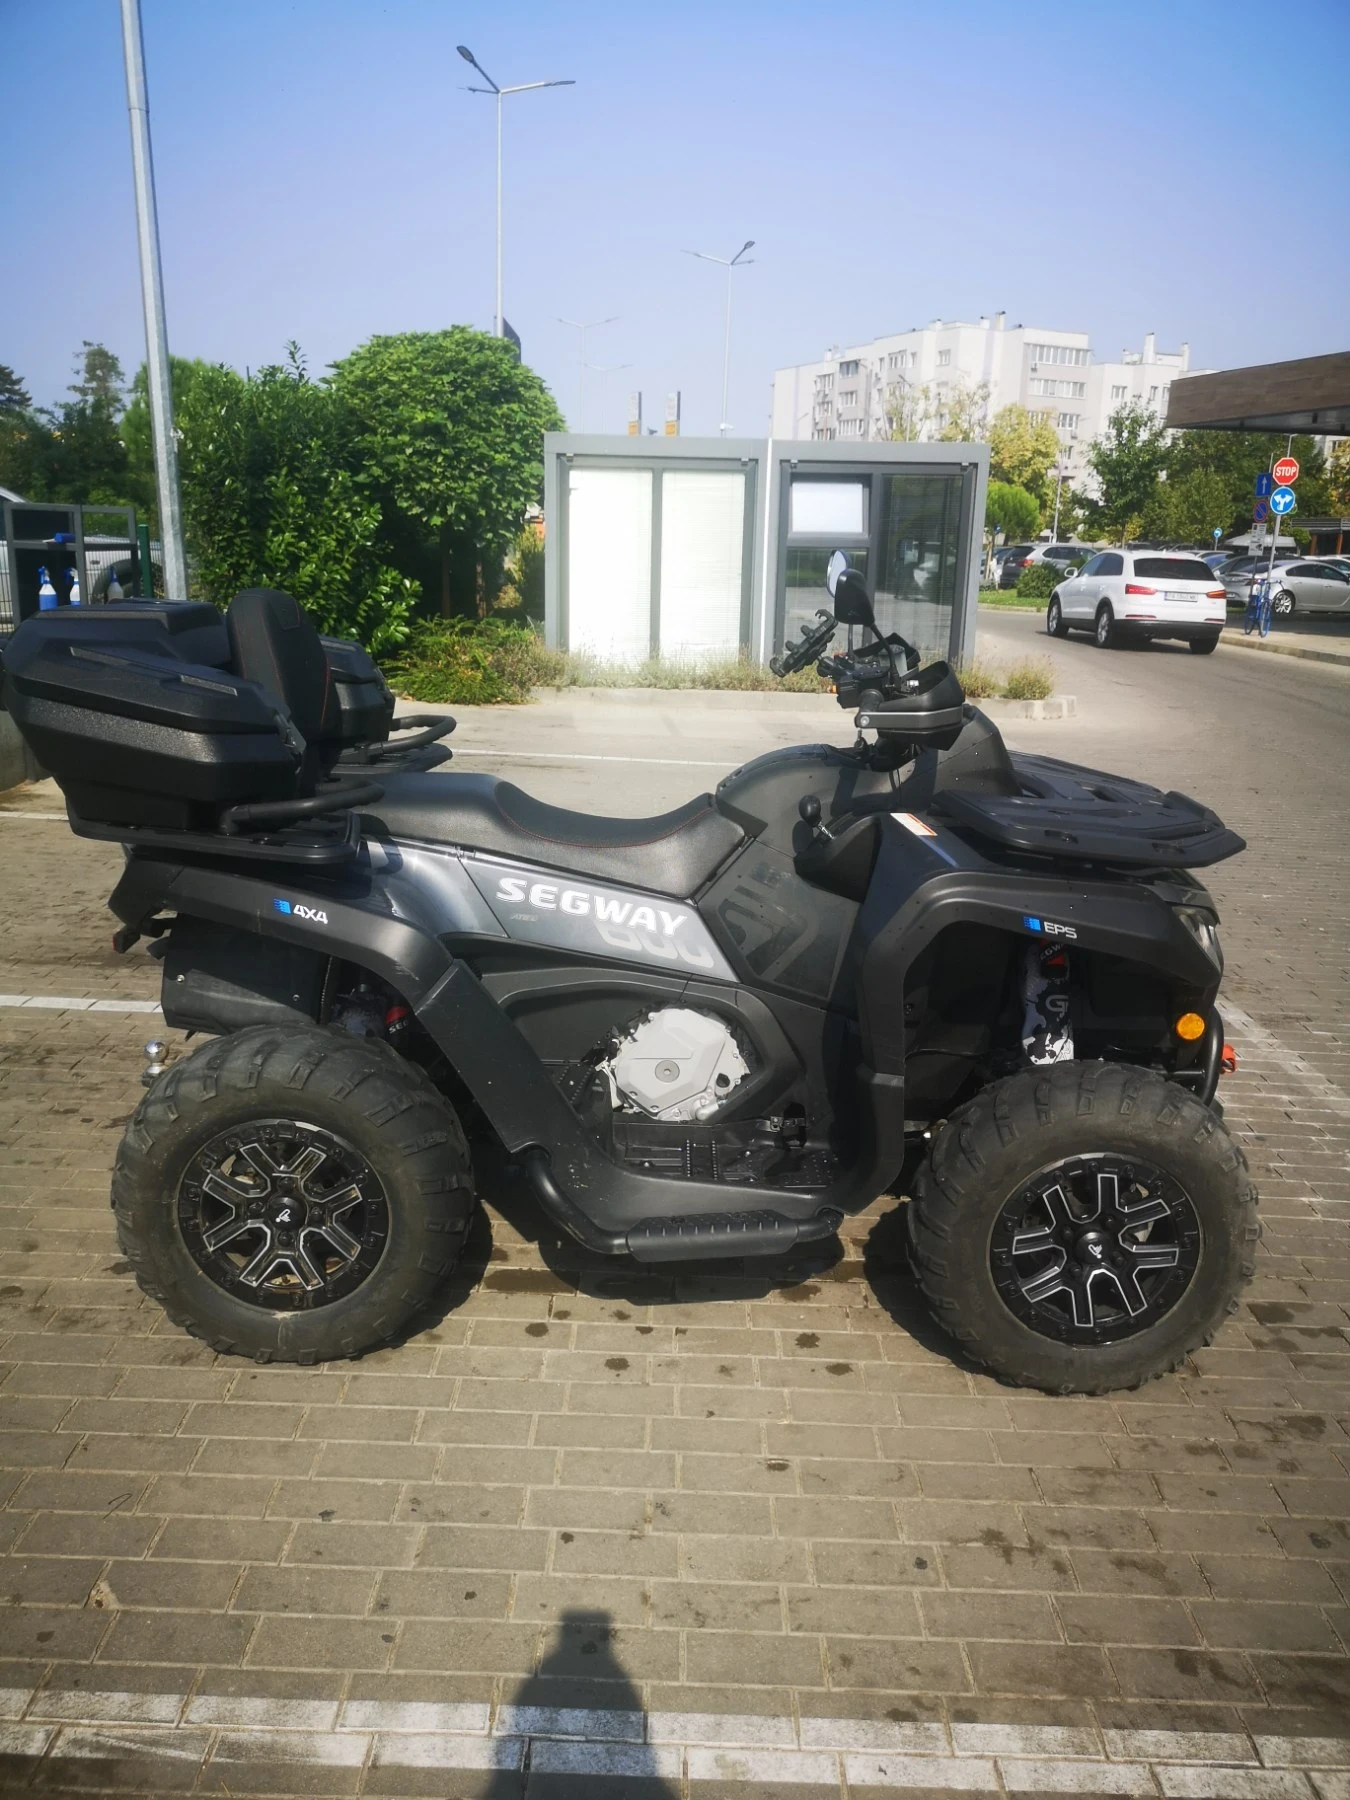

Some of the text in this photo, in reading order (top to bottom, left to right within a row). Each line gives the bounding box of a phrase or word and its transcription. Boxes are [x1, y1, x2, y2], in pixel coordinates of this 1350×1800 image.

[1276, 466, 1297, 477] STOP
[293, 904, 329, 925] 4X4
[496, 877, 688, 937] SEGWAY
[1043, 921, 1078, 939] EPS
